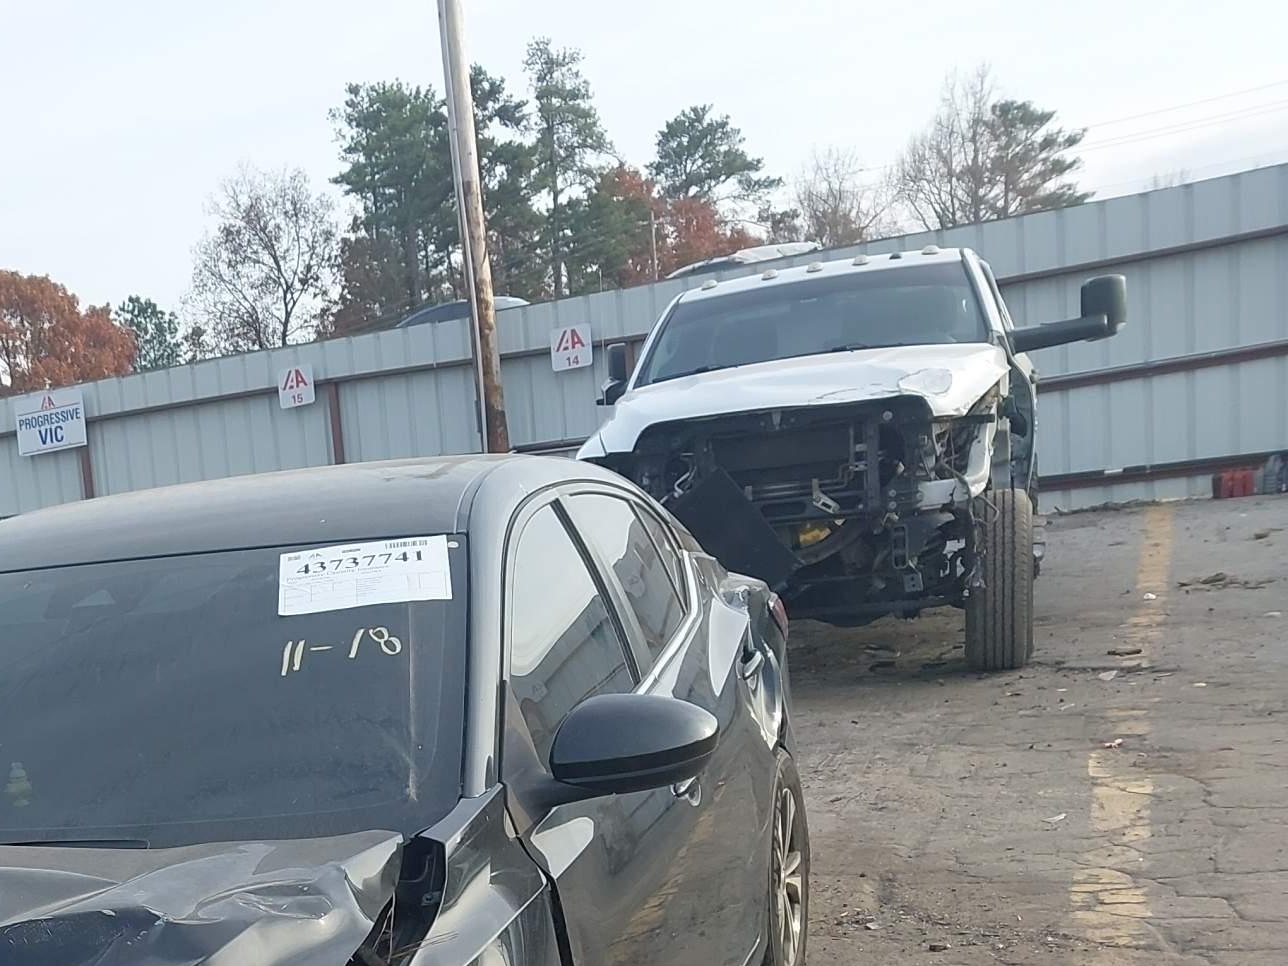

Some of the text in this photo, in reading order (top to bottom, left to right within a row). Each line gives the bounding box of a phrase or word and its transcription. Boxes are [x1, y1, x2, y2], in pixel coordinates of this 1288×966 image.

[566, 355, 579, 367] 14
[292, 393, 304, 404] 15
[18, 407, 81, 431] PROGRESSIVE
[38, 425, 64, 445] VIC
[296, 550, 423, 574] 43737741
